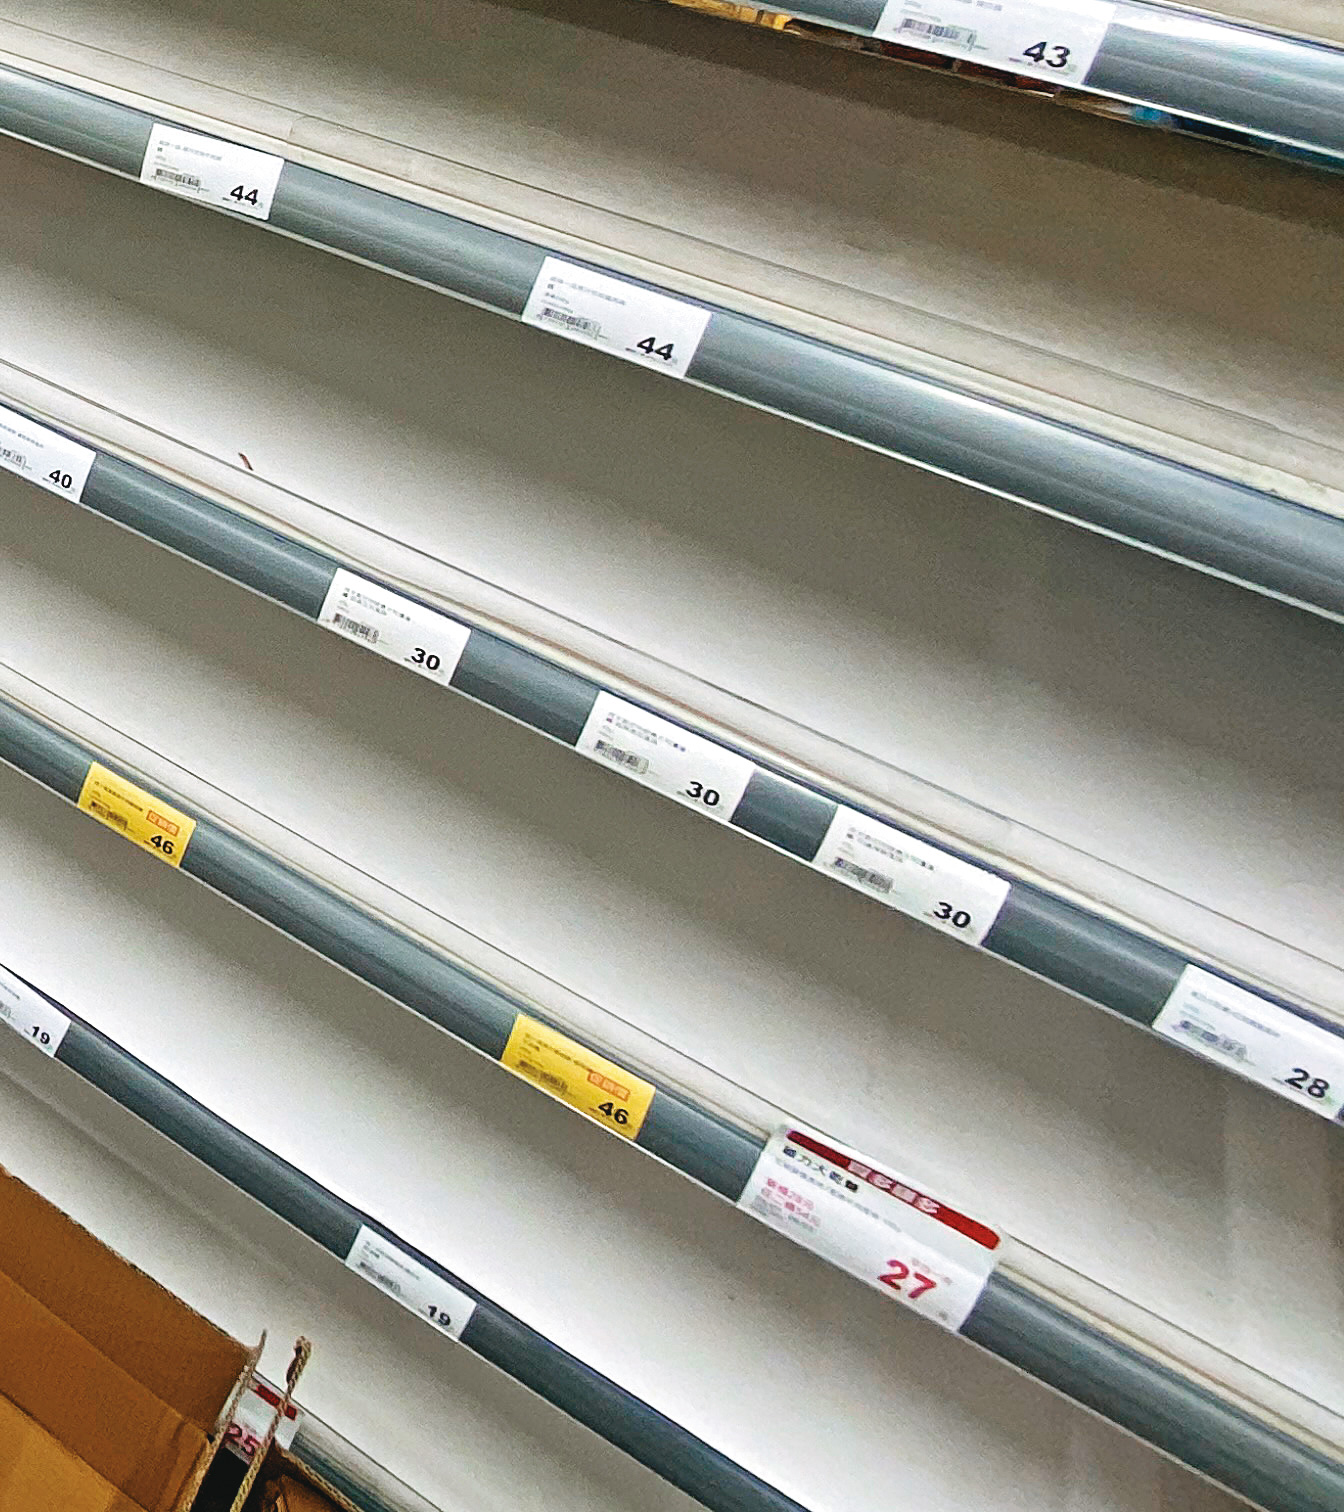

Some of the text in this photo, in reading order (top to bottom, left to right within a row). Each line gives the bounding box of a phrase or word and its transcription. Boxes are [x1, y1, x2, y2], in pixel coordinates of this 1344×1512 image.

[1022, 40, 1071, 70] 43
[230, 185, 259, 206] 44
[636, 336, 674, 361] 44
[48, 469, 73, 490] 40
[411, 647, 441, 671] 30
[685, 780, 721, 808] 30
[150, 834, 174, 855] 46
[933, 901, 972, 930] 30
[31, 1026, 51, 1045] 19
[1284, 1066, 1332, 1101] 28
[599, 1101, 631, 1126] 46
[879, 1259, 937, 1299] 27
[426, 1303, 452, 1327] 19
